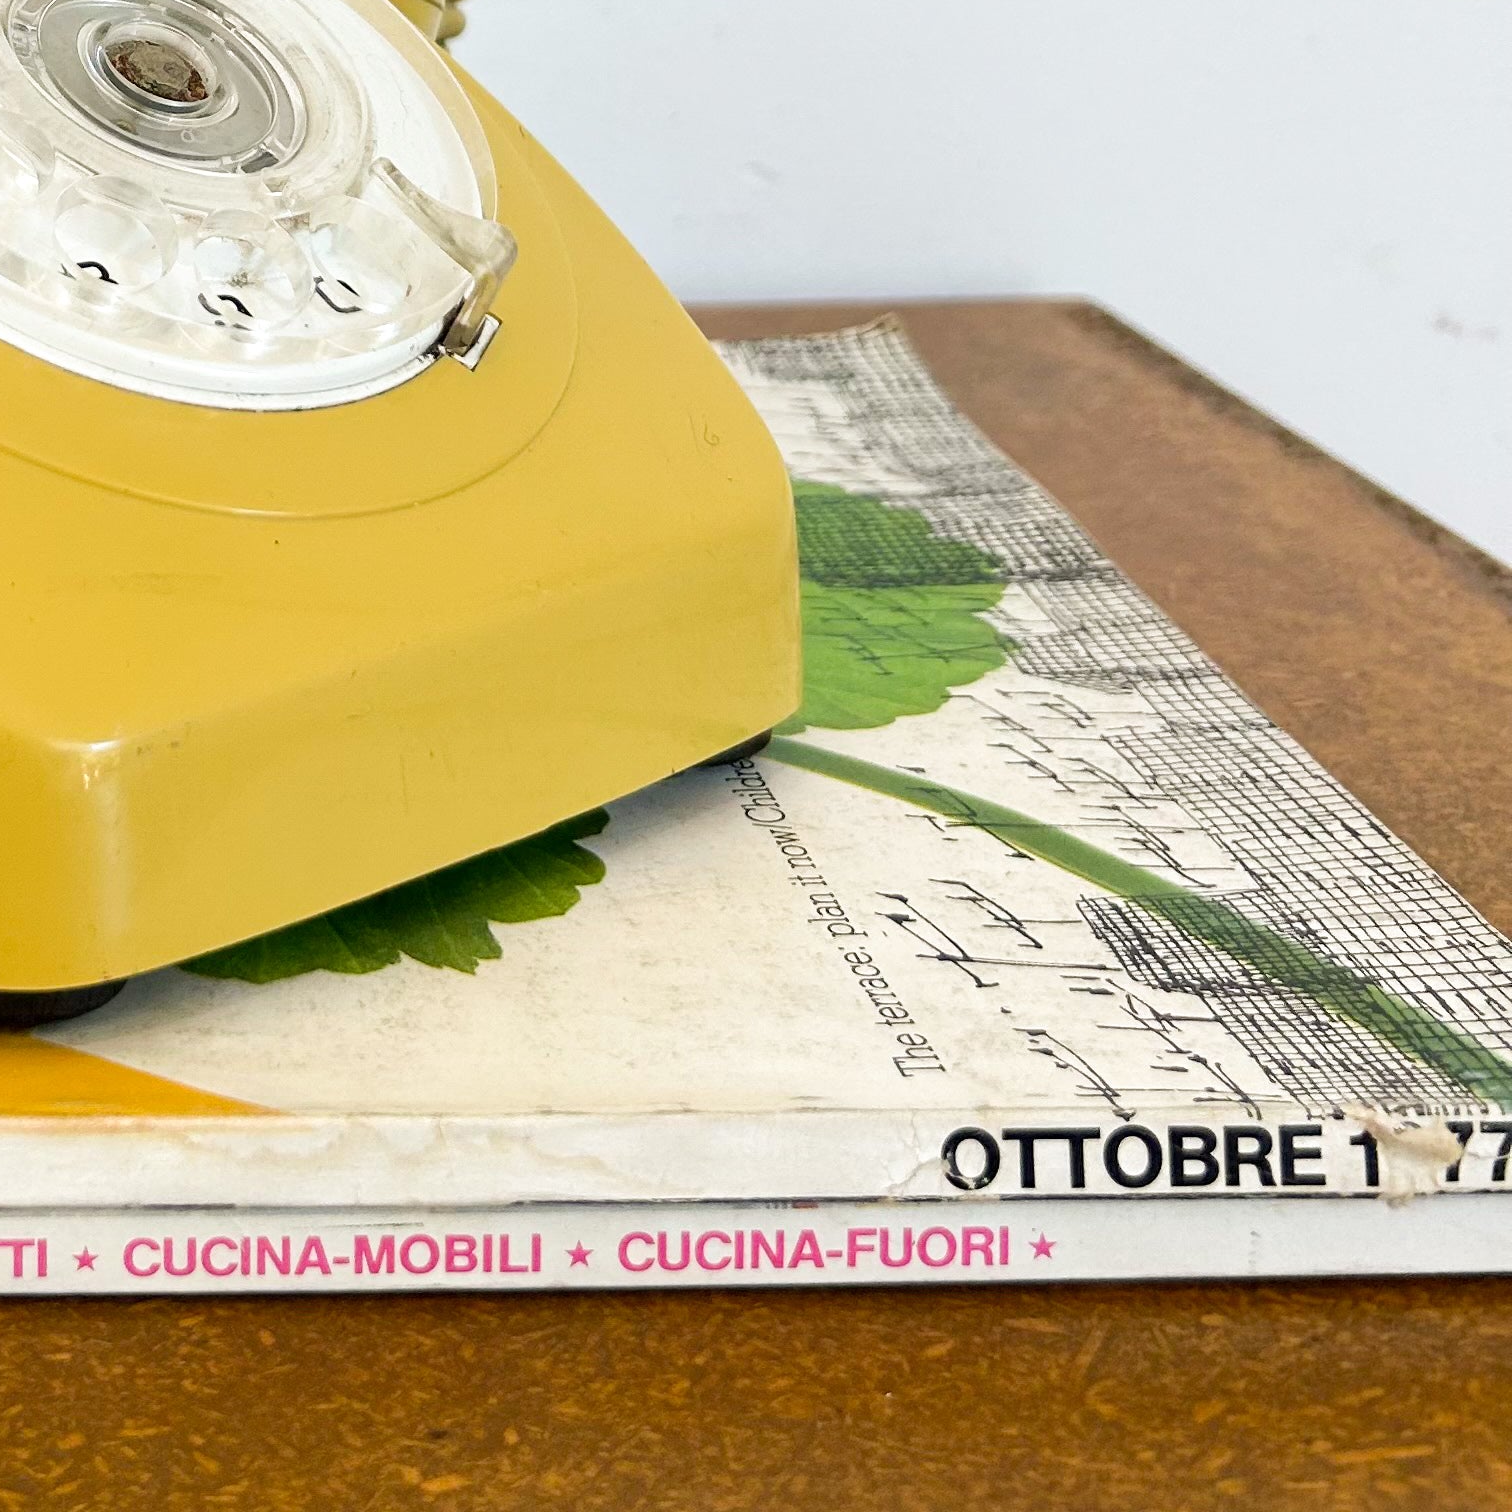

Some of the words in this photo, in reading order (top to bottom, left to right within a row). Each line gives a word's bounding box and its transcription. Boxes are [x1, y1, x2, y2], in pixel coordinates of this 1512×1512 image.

[788, 874, 827, 886] it
[808, 892, 868, 939] plan
[839, 946, 915, 1026] terrace:
[892, 1033, 946, 1077] The
[941, 1123, 1327, 1190] OTTOBRE
[1350, 1121, 1512, 1186] 177
[122, 1232, 541, 1278] CUCINA-MOBILI
[618, 1224, 1010, 1272] CUCINA-FUORI
